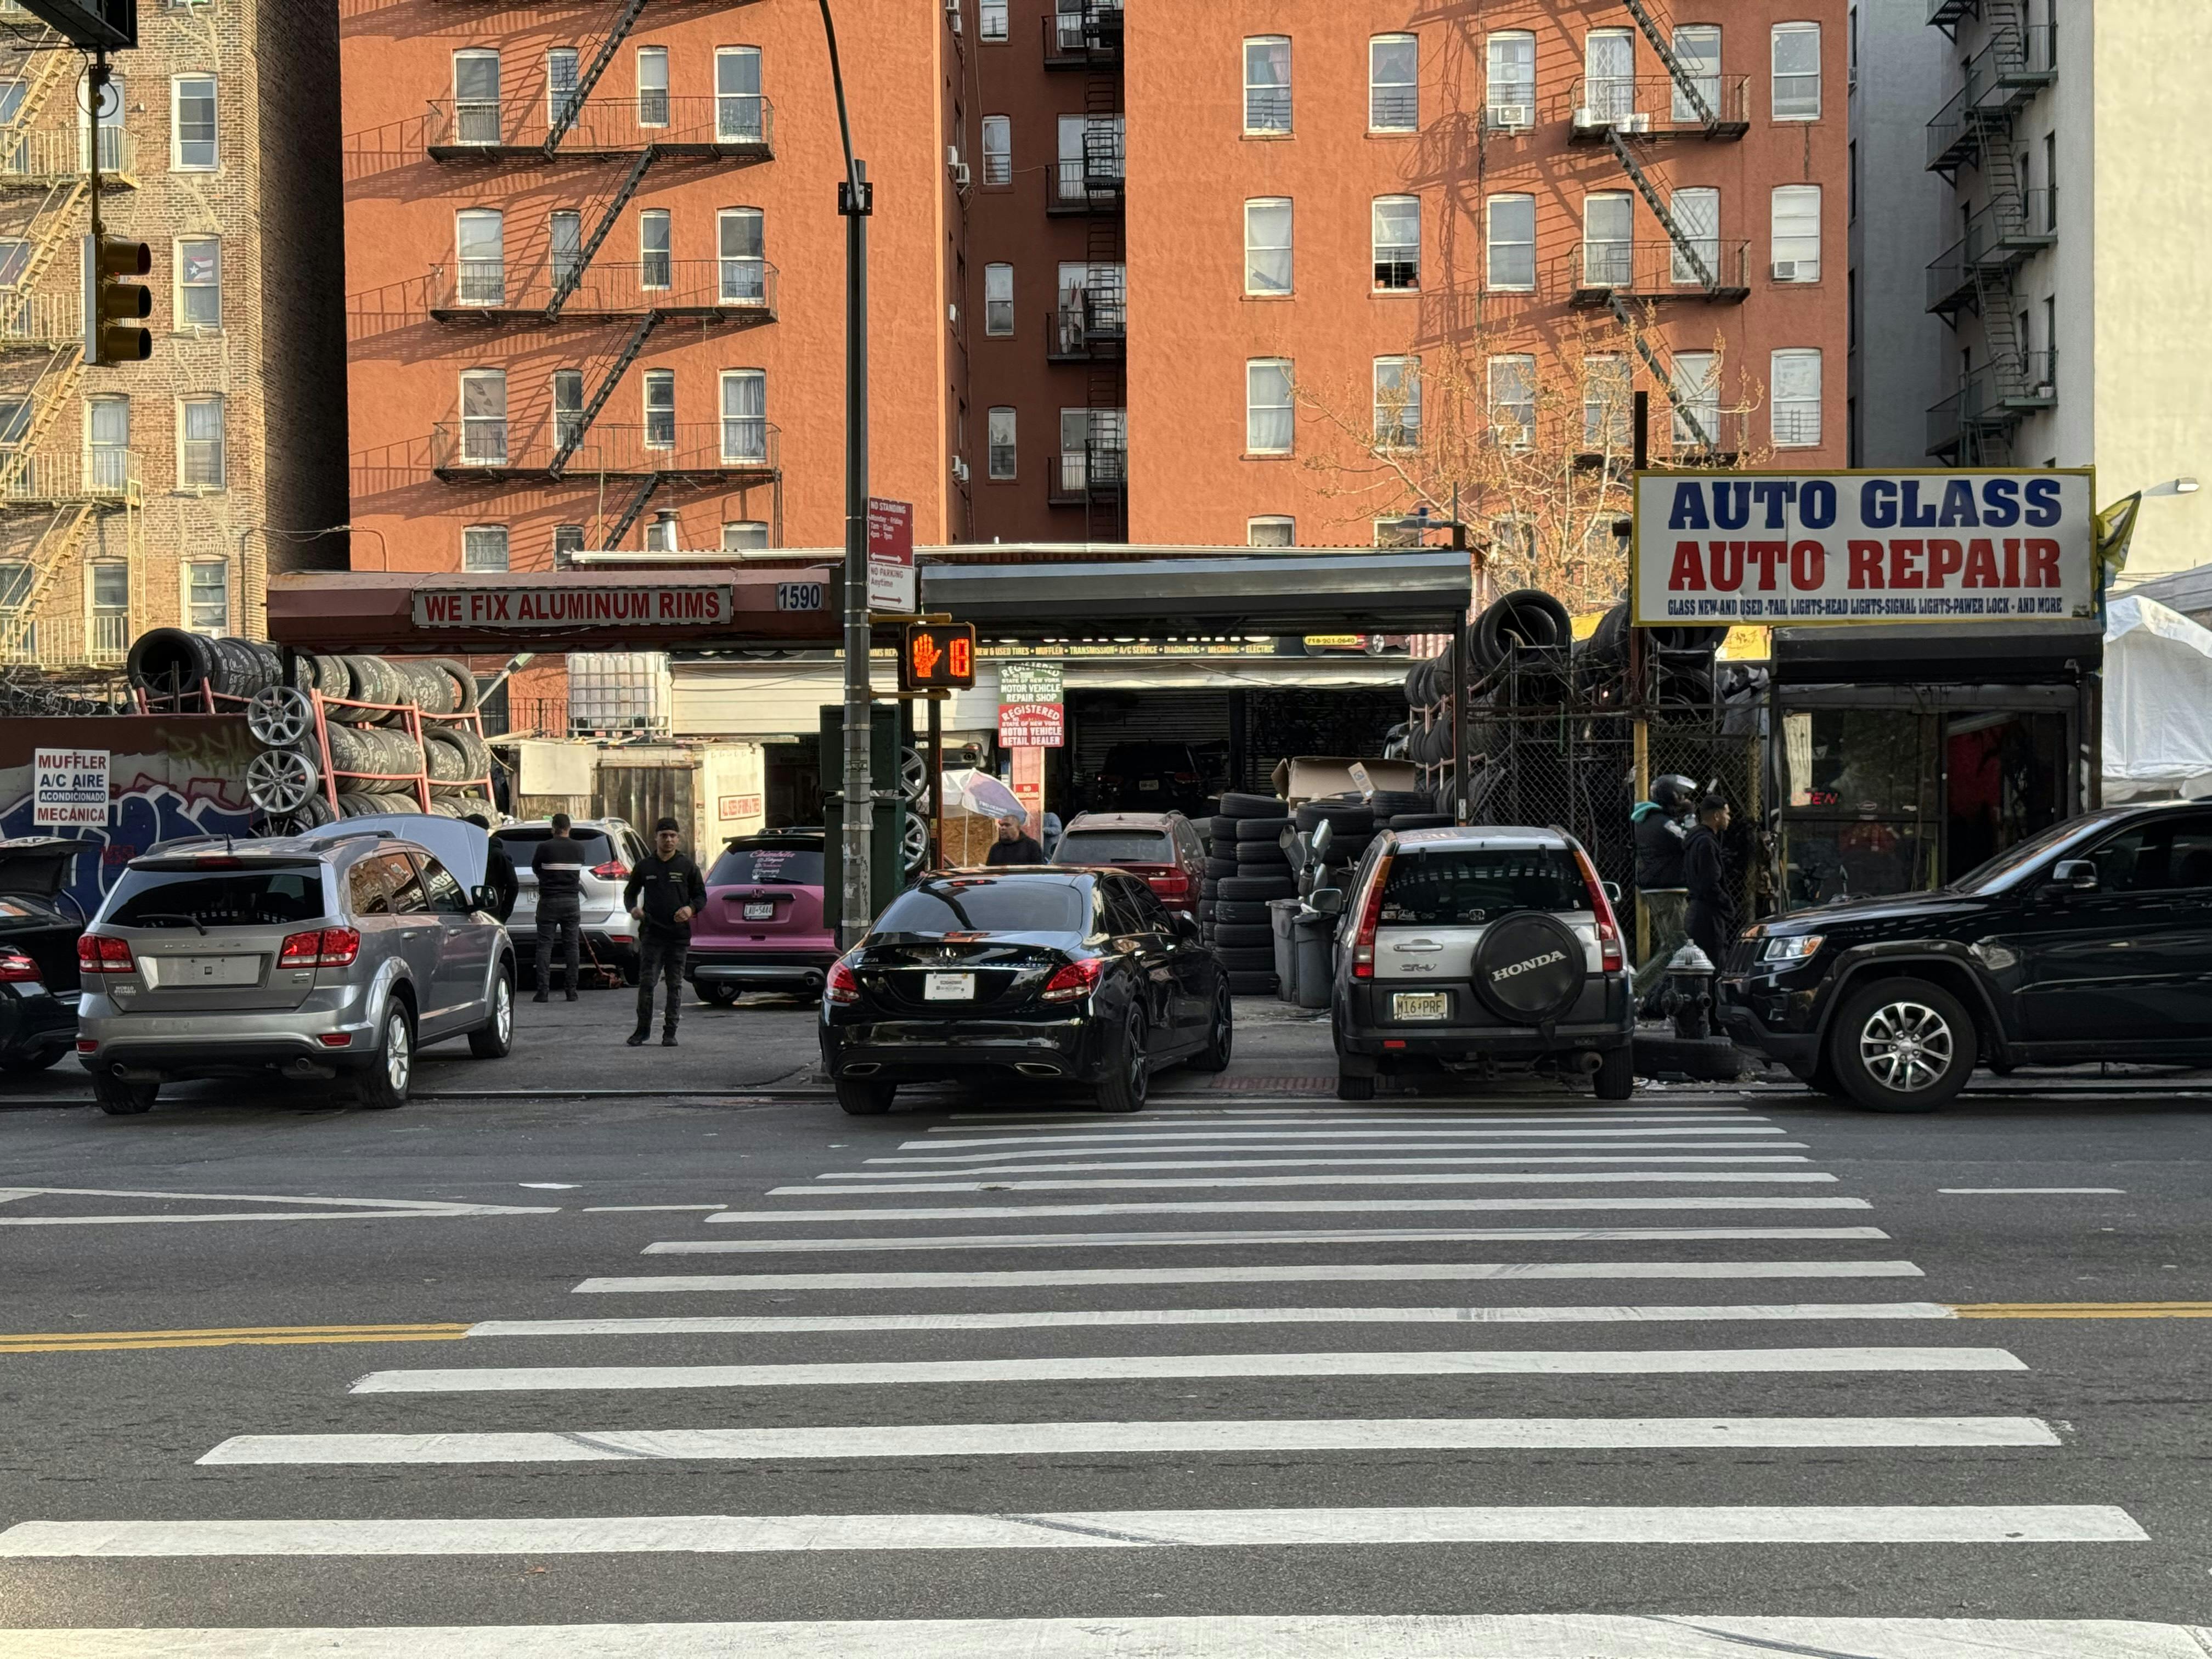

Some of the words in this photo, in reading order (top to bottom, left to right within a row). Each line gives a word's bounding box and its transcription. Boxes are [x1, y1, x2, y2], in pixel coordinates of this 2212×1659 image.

[871, 501, 878, 510] NO
[879, 502, 906, 514] STANDING
[1668, 481, 1836, 530] AUTO
[1861, 479, 2062, 528] GLASS
[1668, 540, 1825, 591] AUTO
[1847, 539, 2061, 589] REPAIR
[871, 567, 878, 575] NO
[880, 568, 903, 578] PARKING
[871, 579, 893, 588] Anytime
[780, 585, 820, 608] 1590
[425, 595, 462, 621] WE
[471, 594, 510, 620] FIX
[518, 592, 650, 620] ALUMINUM
[659, 592, 719, 618] RIMS
[1668, 599, 1695, 615] GLASS
[1740, 599, 1762, 614] USED
[1986, 598, 2009, 614] LOCK
[2017, 597, 2035, 613] AND
[2038, 597, 2062, 613] MORE
[1012, 647, 1029, 655] TIRES
[1036, 647, 1063, 655] MUFFLER
[1070, 646, 1114, 654] TRANSMISSION
[1119, 646, 1131, 654] A/C
[1133, 646, 1157, 654] SERVICE
[1164, 646, 1199, 654] DIAGNOSTIC
[1207, 646, 1239, 654] MECHANIC
[1246, 645, 1274, 653] ELECTRIC
[1001, 685, 1027, 693] MOTOR
[1029, 684, 1061, 692] VEHICLE
[1006, 693, 1034, 702] REPAIR
[1036, 693, 1057, 702] SHOP
[1001, 704, 1060, 721] REGISTERED
[1001, 727, 1028, 736] MOTOR
[1030, 727, 1062, 736] VEHICLE
[1002, 737, 1029, 746] RETAIL
[1031, 736, 1060, 745] DEALER
[38, 755, 106, 769] MUFFLER
[40, 774, 66, 787] A/C
[71, 774, 104, 787] AIRE
[41, 792, 104, 801] ACONDICIONADO
[1400, 963, 1437, 972] CR-V
[1492, 950, 1567, 981] HONDA
